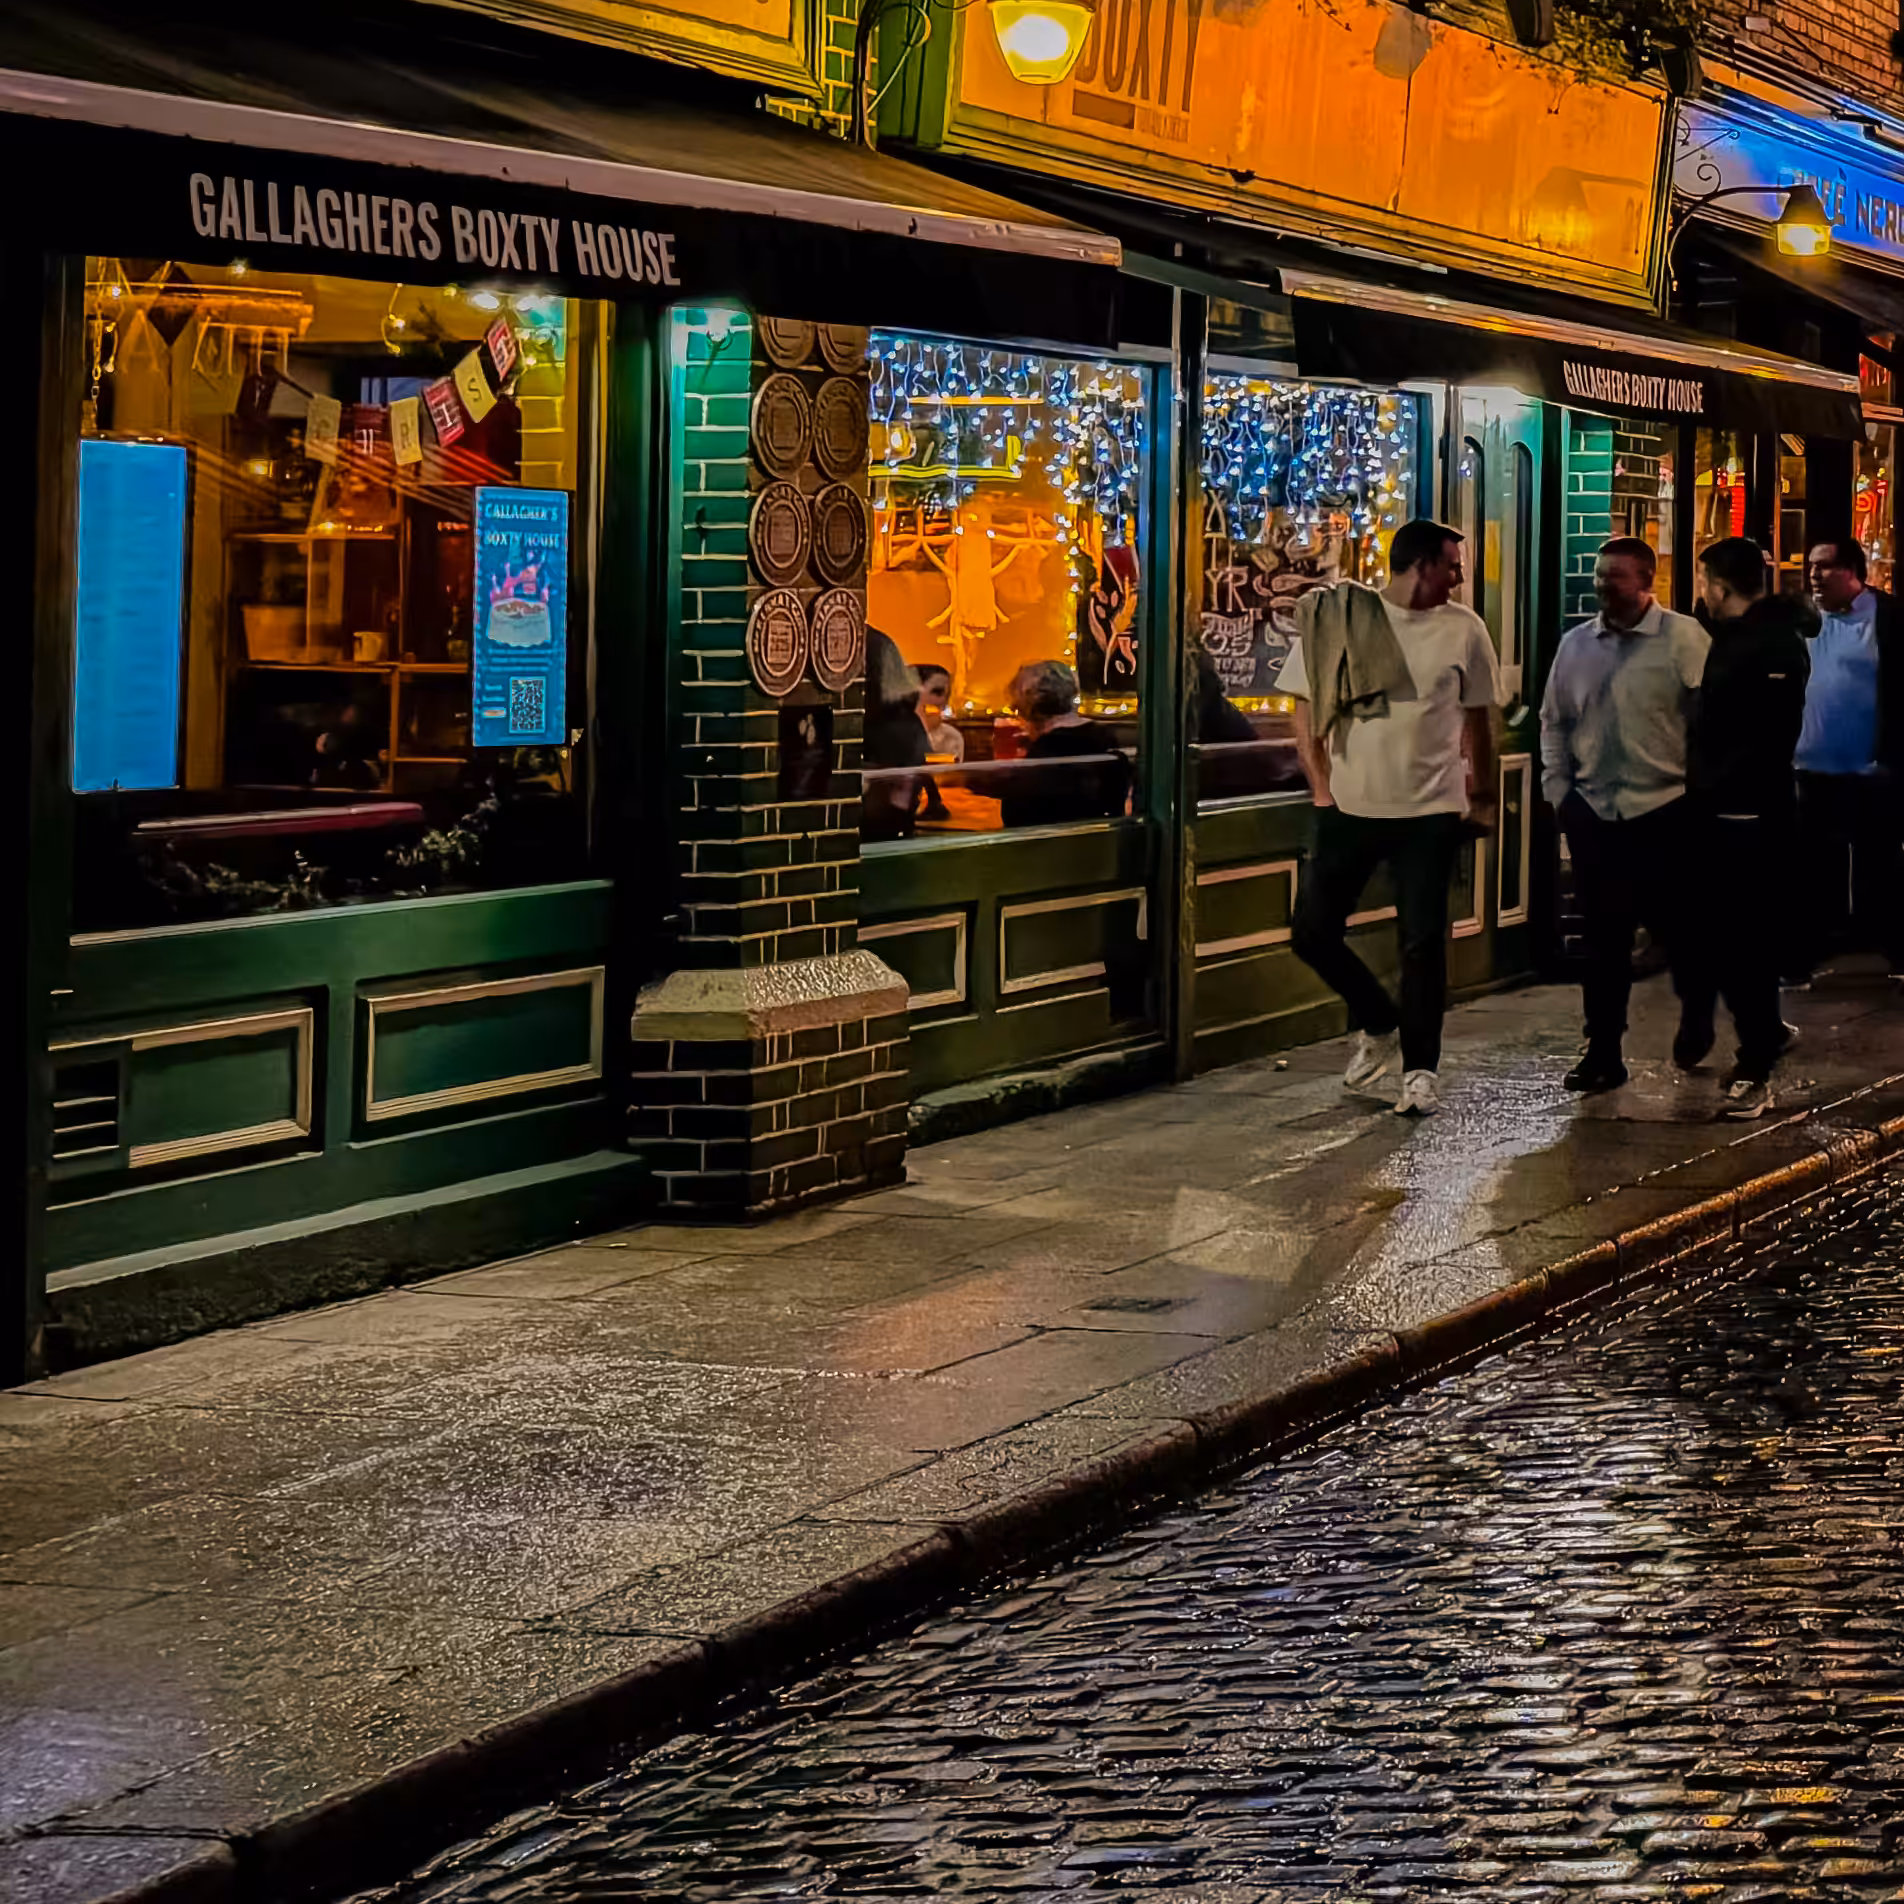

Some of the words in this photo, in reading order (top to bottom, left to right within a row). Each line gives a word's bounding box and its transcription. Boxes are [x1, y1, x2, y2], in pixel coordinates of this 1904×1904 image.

[188, 172, 442, 262] GALLAGHERS
[451, 205, 559, 273] BOXTY
[571, 220, 682, 286] HOUSE
[1631, 373, 1667, 411] BOXTY
[1667, 378, 1704, 414] HOUSE
